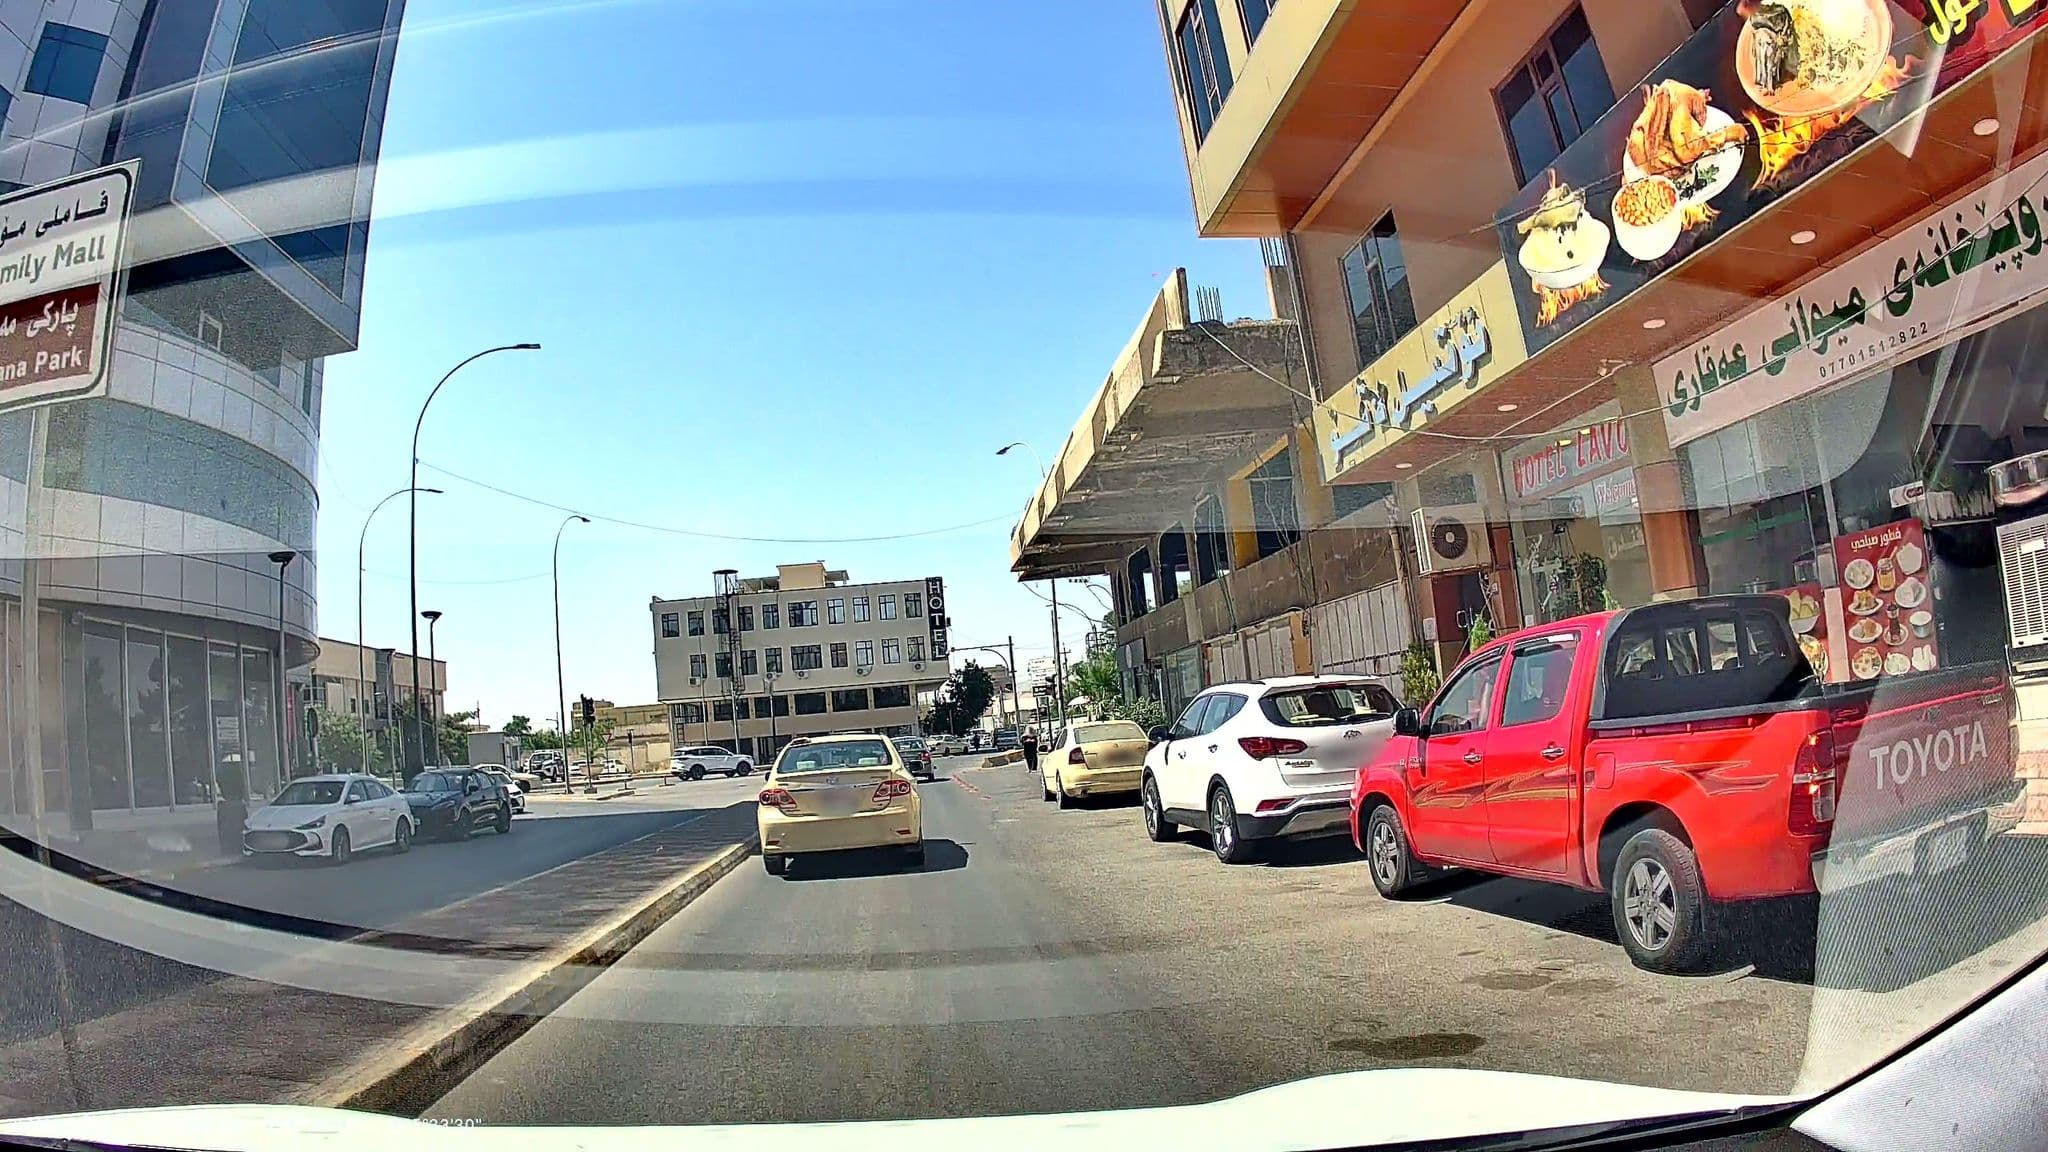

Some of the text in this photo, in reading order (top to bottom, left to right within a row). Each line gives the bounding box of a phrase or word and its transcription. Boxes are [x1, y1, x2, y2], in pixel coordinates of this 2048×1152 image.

[53, 235, 106, 270] Mall
[34, 345, 86, 374] Park
[1819, 321, 1928, 378] 07701512822
[1512, 442, 1567, 498] HOTEL
[1880, 527, 1902, 548] فطور
[928, 581, 947, 658] HOTEL
[1868, 720, 1988, 790] TOYOTA
